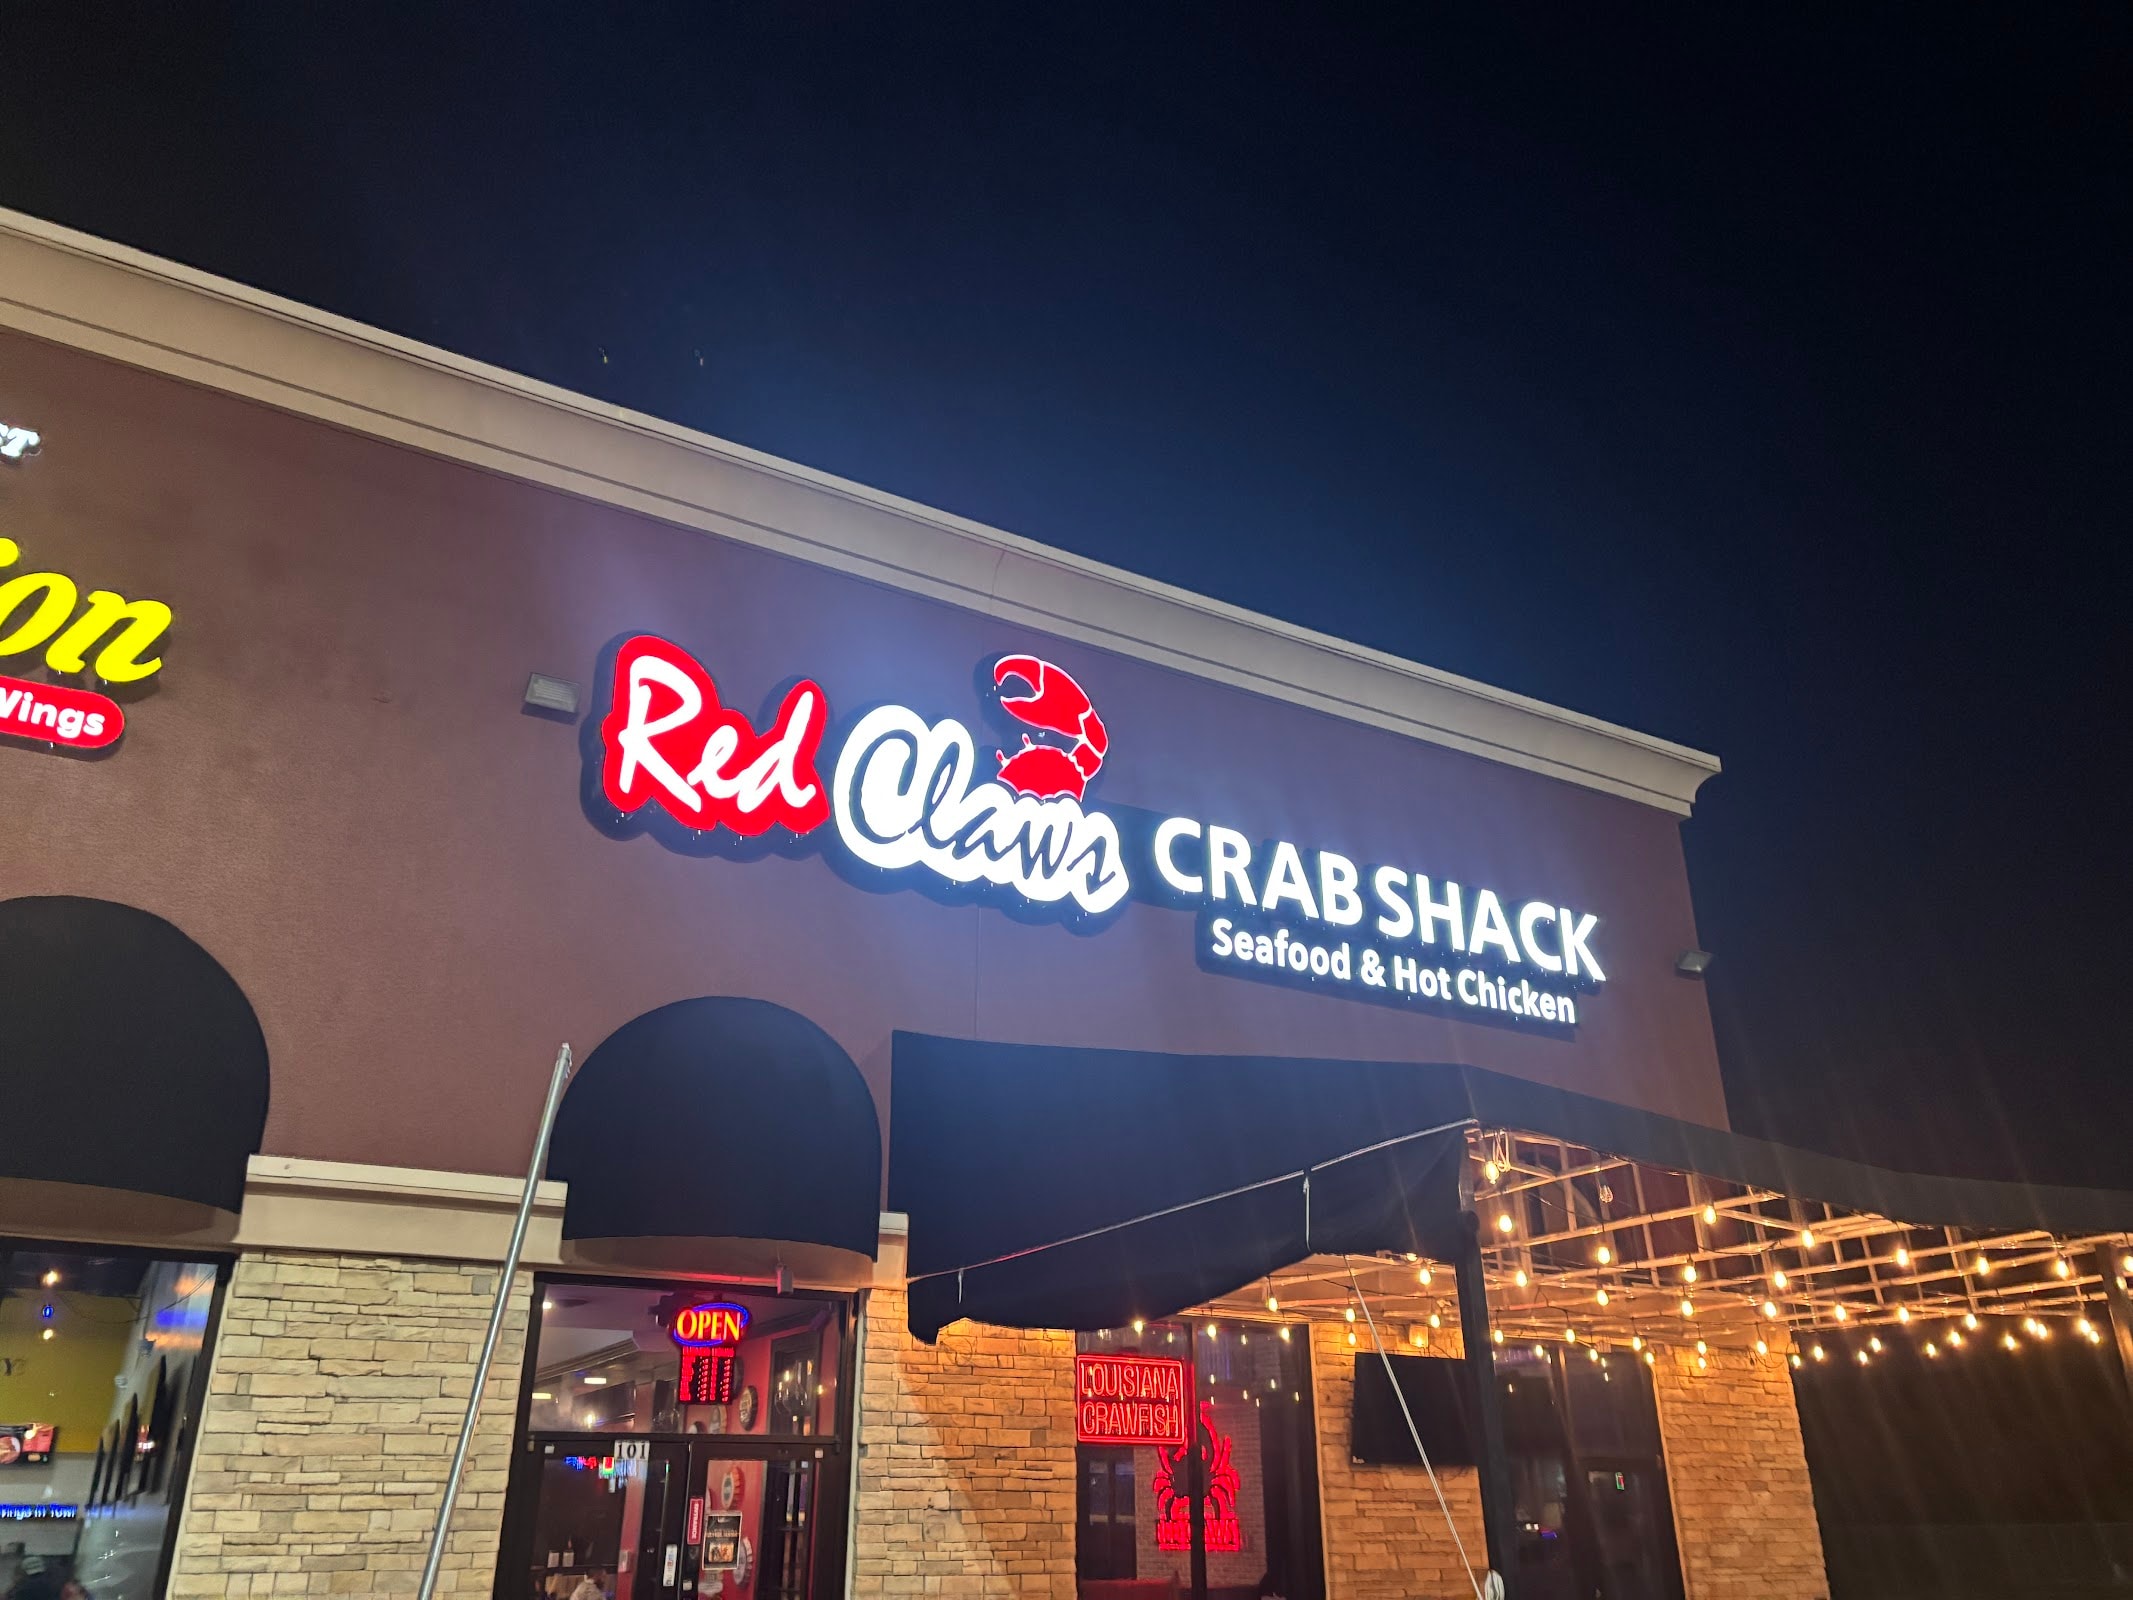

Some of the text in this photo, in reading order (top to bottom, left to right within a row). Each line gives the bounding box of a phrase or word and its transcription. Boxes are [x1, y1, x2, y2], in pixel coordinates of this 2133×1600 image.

[618, 655, 1117, 897] Red Claws
[1154, 817, 1606, 982] CRAB SHACK
[1212, 918, 1575, 1024] Seafood & Hot Chicken
[677, 1309, 740, 1341] OPEN
[1081, 1363, 1178, 1399] LOUISIANA
[1083, 1401, 1178, 1437] CRAWFISH
[617, 1444, 646, 1460] 101
